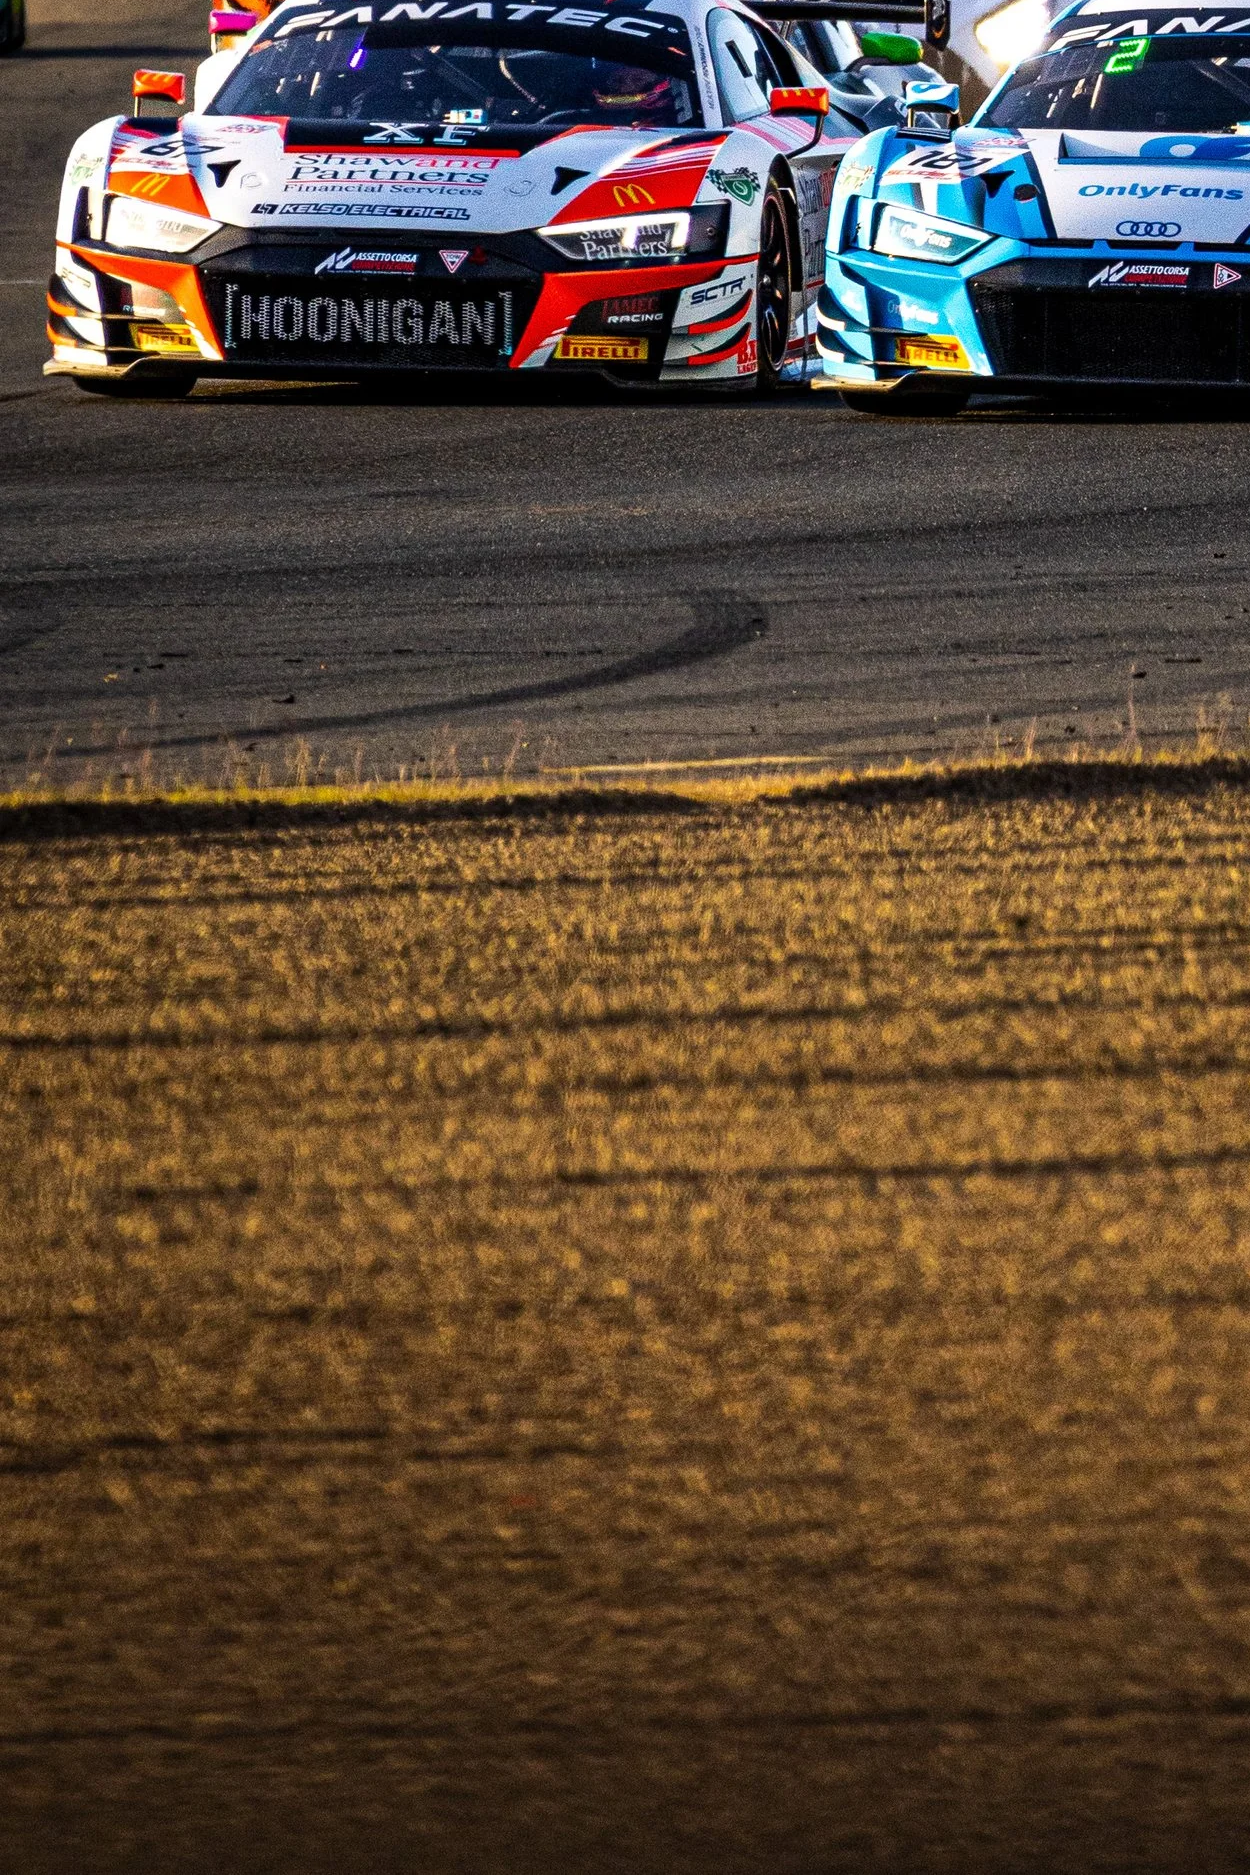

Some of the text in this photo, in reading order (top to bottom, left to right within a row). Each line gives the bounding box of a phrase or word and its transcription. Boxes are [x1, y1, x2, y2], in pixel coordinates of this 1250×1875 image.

[274, 1, 666, 38] FANATEC
[1105, 39, 1152, 74] 2
[294, 153, 501, 170] Shaw and
[289, 166, 490, 184] Partners
[284, 183, 483, 196] Financial Services
[1078, 183, 1244, 201] OnlyFans
[282, 203, 472, 220] KELSO ELECTRICAL
[355, 251, 418, 263] ASSETTO CORSA
[1128, 264, 1190, 276] ASSETTO CORSA
[690, 276, 746, 305] SCTR
[607, 312, 664, 324] RACING
[562, 337, 641, 358] PIRELLI
